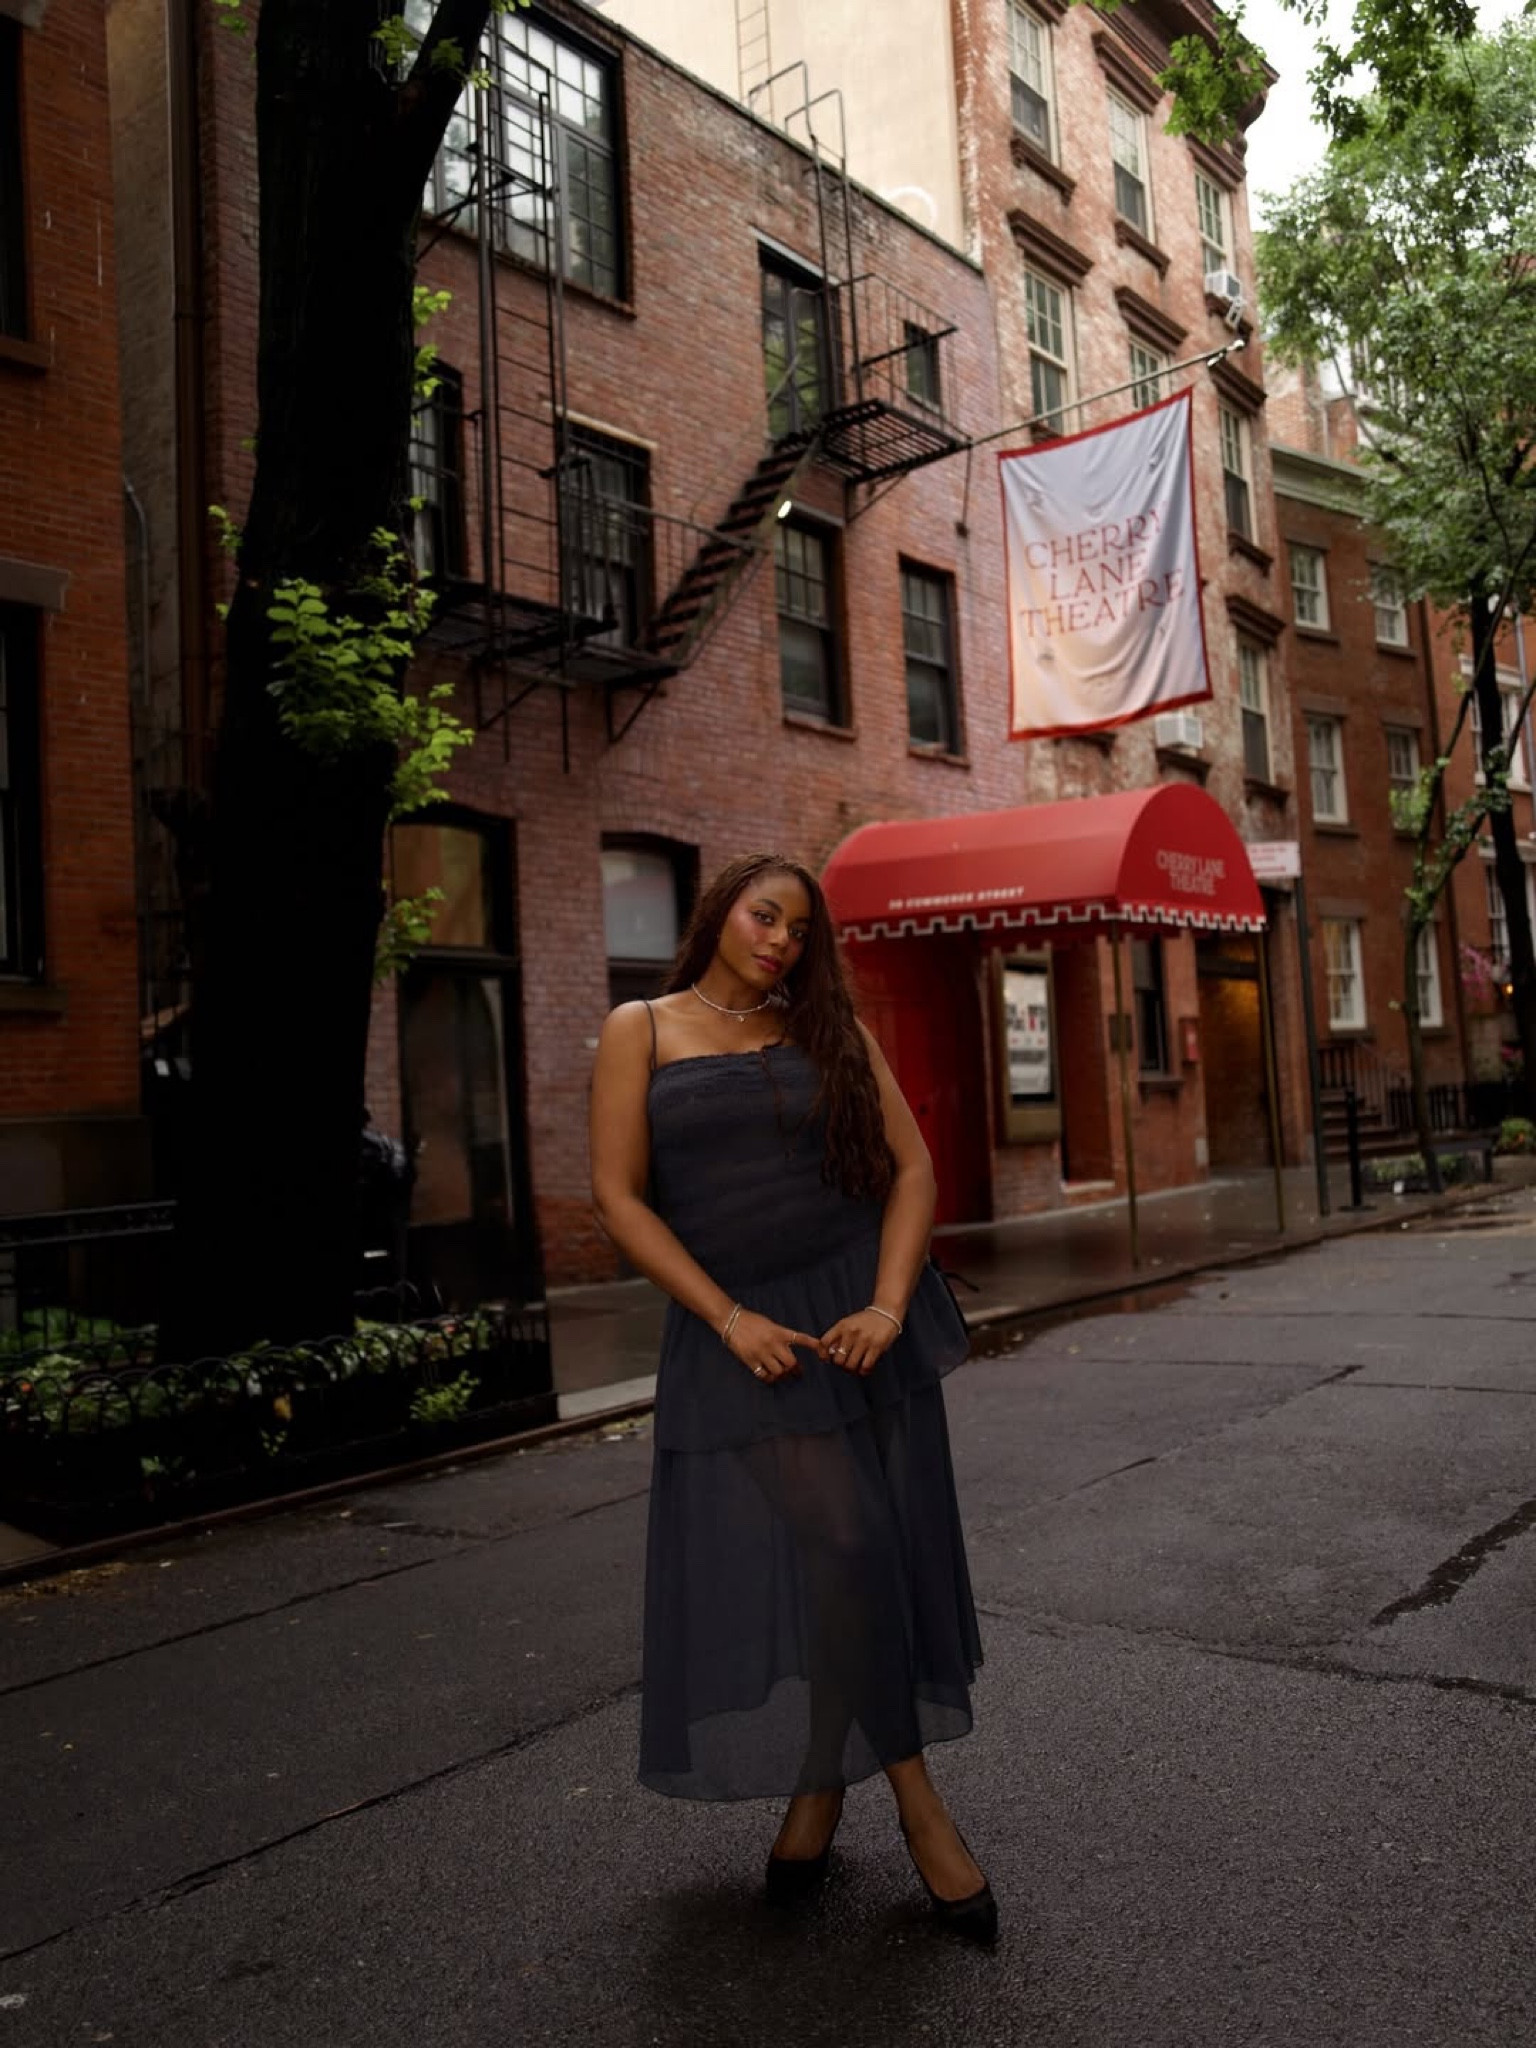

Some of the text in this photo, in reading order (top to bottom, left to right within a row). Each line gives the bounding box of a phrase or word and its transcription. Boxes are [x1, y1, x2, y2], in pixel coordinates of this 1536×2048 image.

[1024, 503, 1166, 570] CHERRY
[1019, 568, 1185, 638] THEATRE
[1050, 548, 1147, 601] LANE
